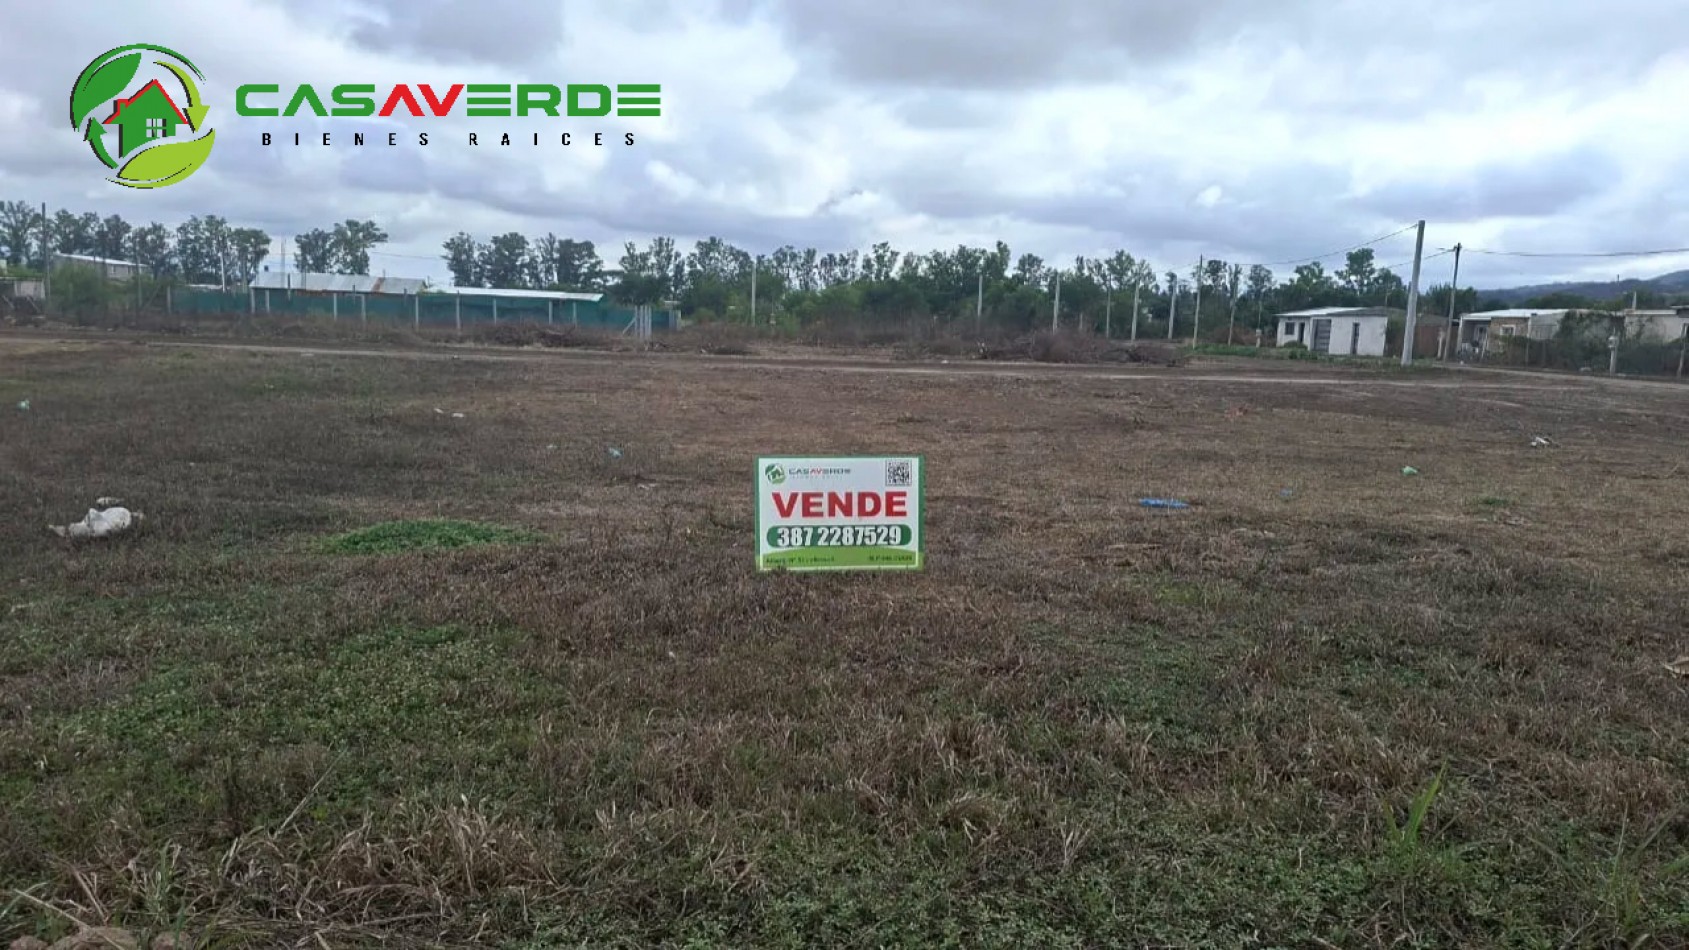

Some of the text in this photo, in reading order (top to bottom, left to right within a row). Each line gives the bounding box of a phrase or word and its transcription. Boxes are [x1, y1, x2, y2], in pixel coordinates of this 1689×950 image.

[788, 467, 851, 475] CASAV
[772, 491, 907, 518] VENDE
[777, 526, 902, 547] 387 2287529
